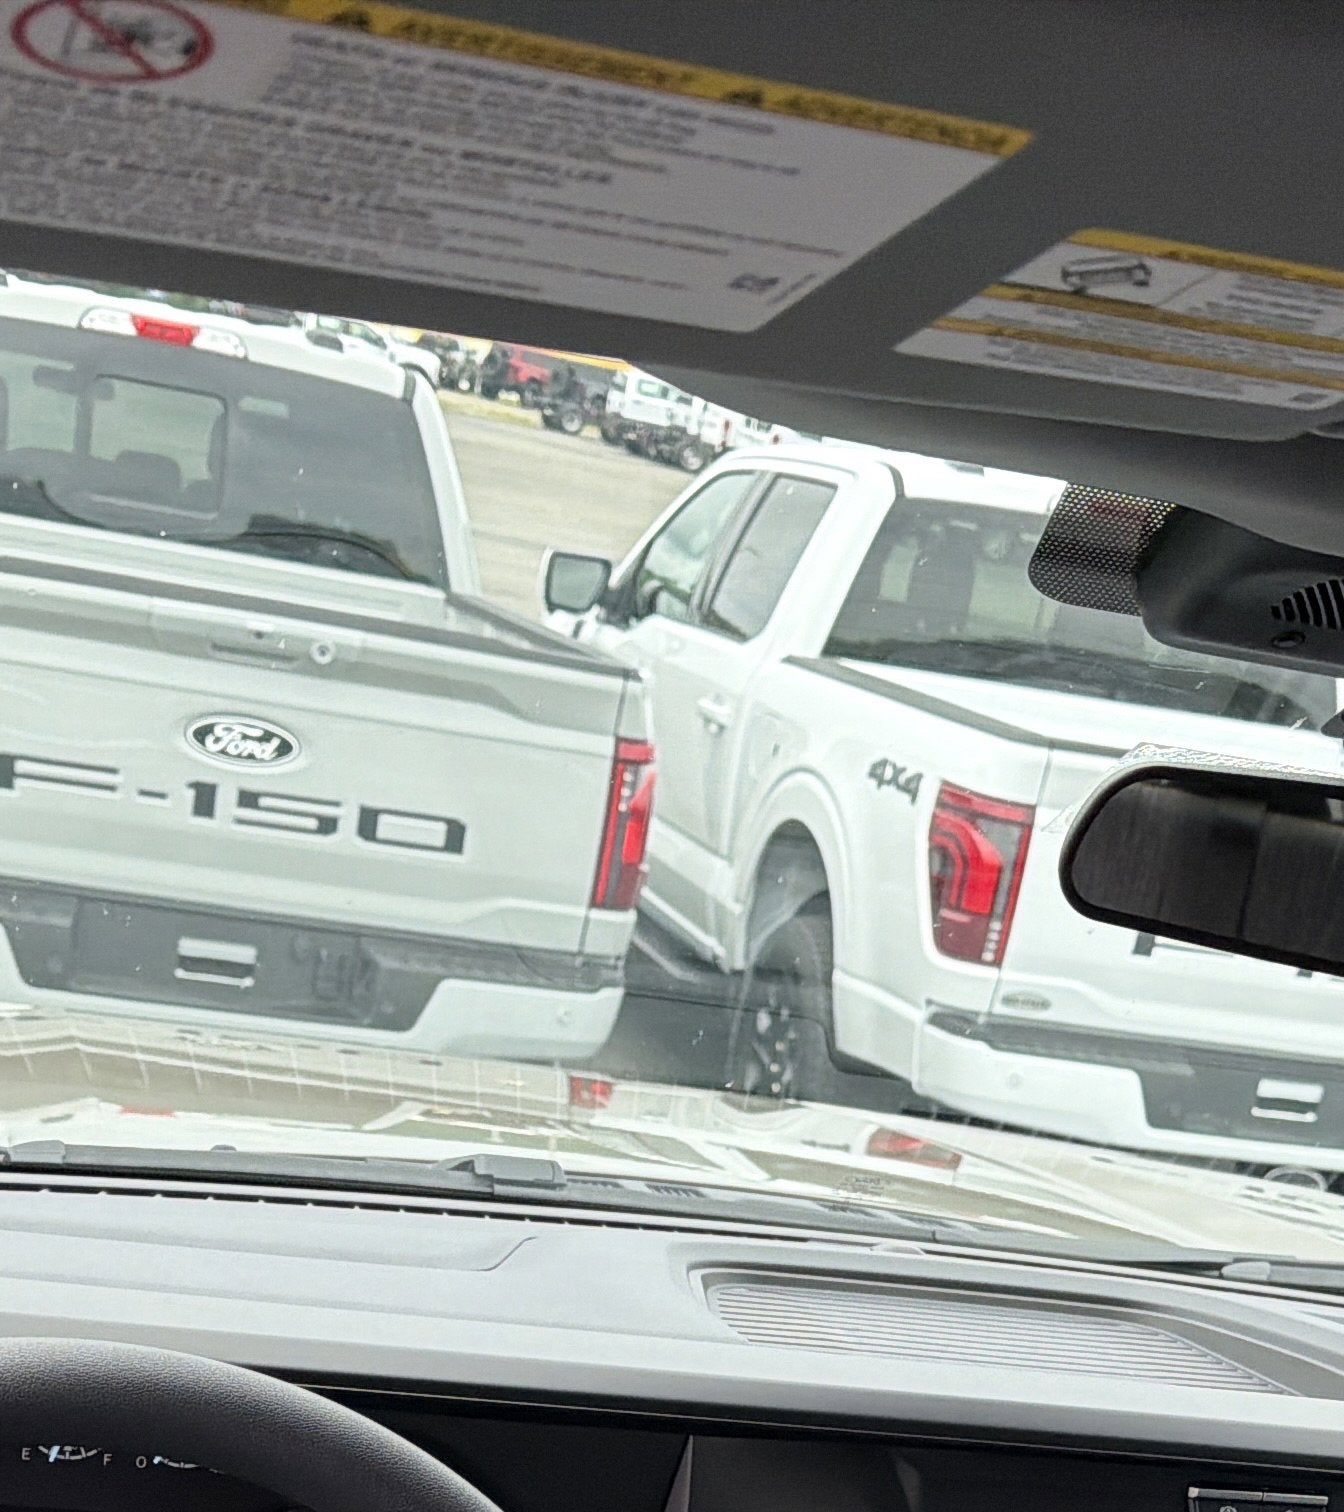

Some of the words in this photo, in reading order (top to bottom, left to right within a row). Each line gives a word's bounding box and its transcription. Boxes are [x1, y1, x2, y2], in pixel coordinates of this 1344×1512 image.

[205, 720, 279, 761] Ford
[21, 1447, 32, 1461] E
[102, 1453, 113, 1467] F
